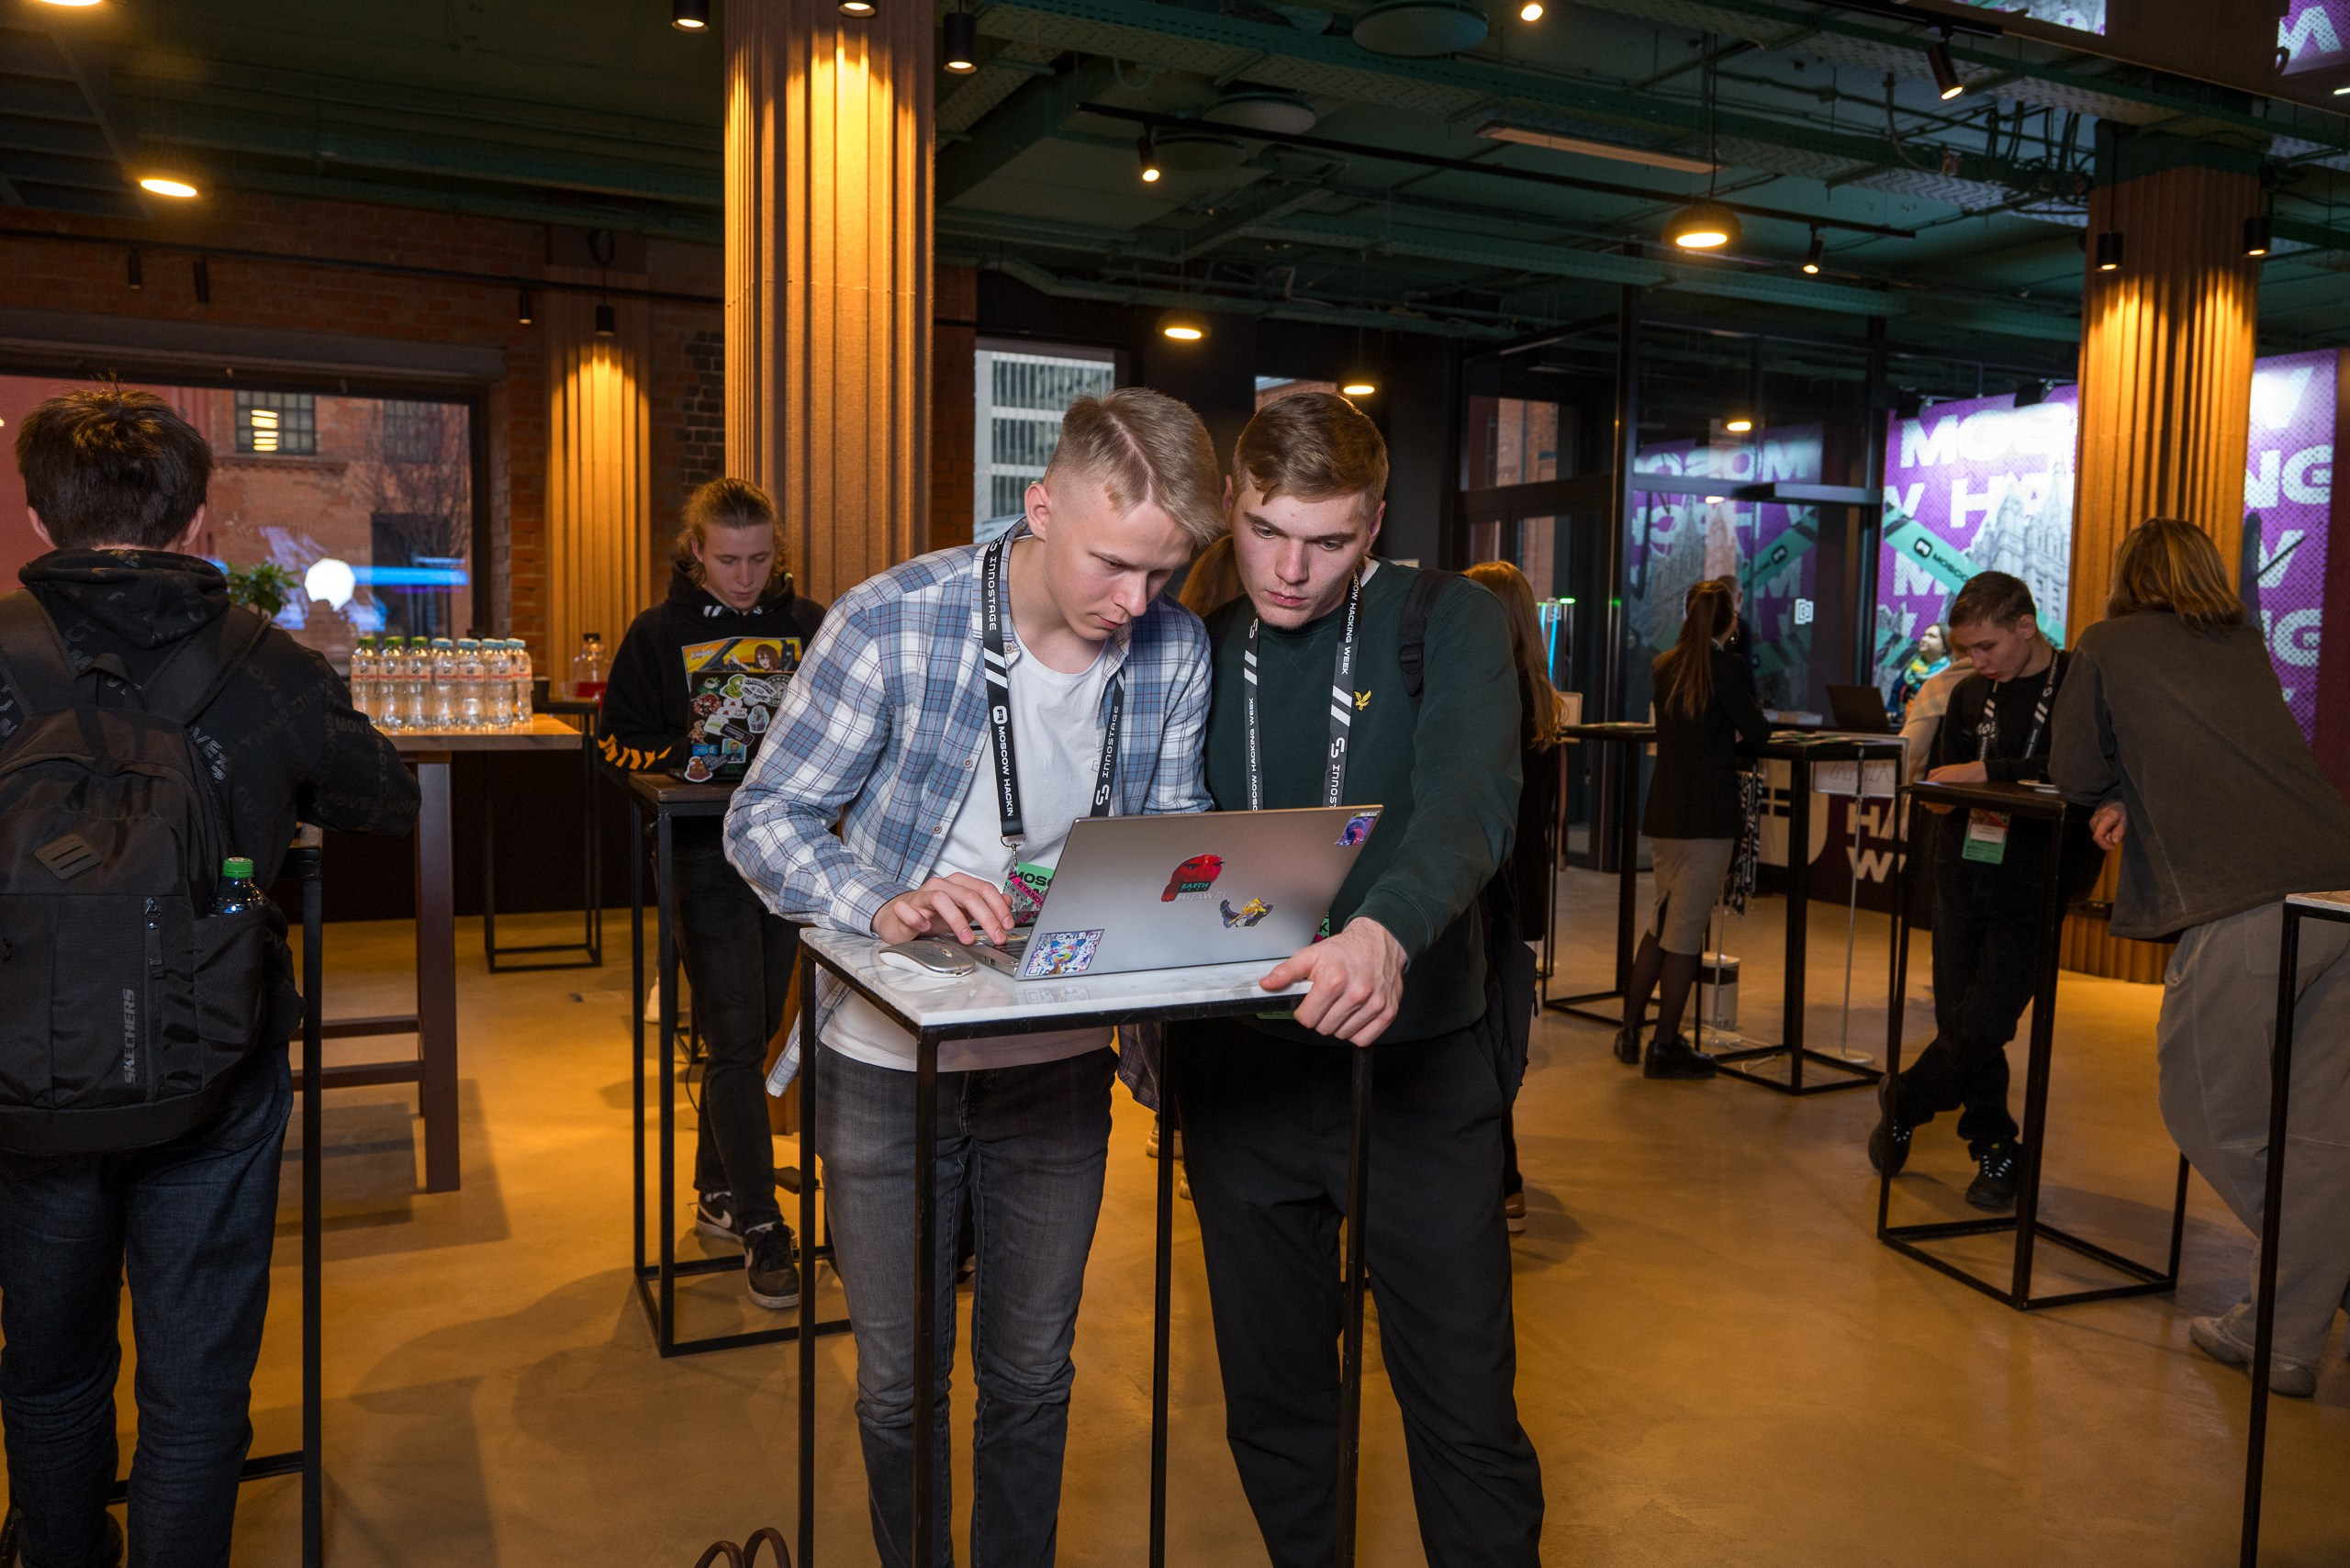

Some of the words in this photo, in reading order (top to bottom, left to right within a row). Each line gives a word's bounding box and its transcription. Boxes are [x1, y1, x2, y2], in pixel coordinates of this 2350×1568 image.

[1932, 553, 1969, 582] MOSCO
[1346, 603, 1357, 644] HACKING
[1341, 646, 1351, 675] WEEK
[998, 725, 1010, 776] MOSCOW
[1003, 778, 1014, 817] HACKIN
[1176, 891, 1226, 901] HUAWEI
[123, 988, 136, 1084] SKECHERS
